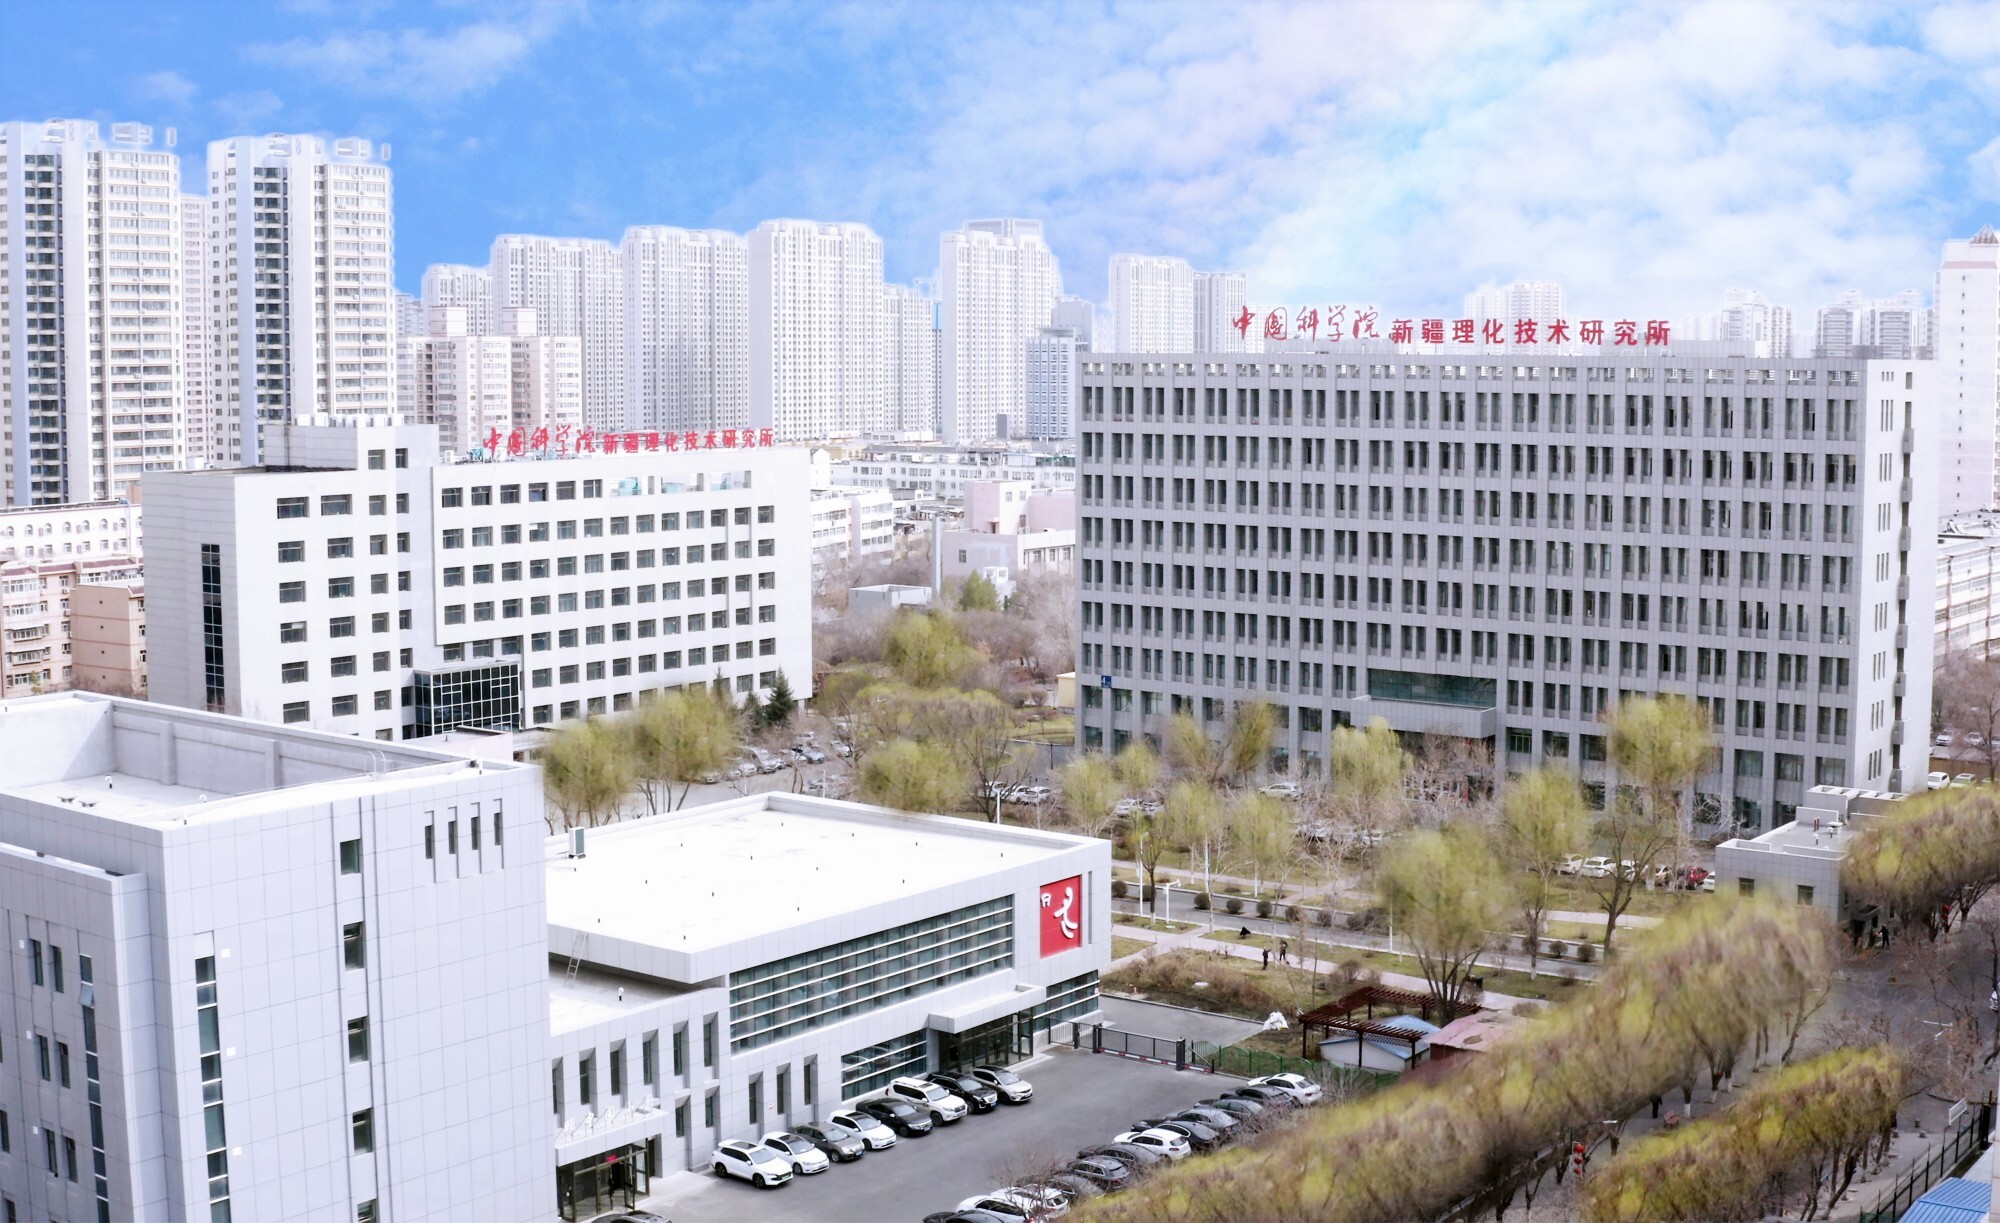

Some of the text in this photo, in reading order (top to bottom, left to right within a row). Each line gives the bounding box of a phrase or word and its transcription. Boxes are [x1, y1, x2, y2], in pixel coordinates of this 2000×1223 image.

[1232, 304, 1670, 346] 中国科学院新疆理化技术研究所
